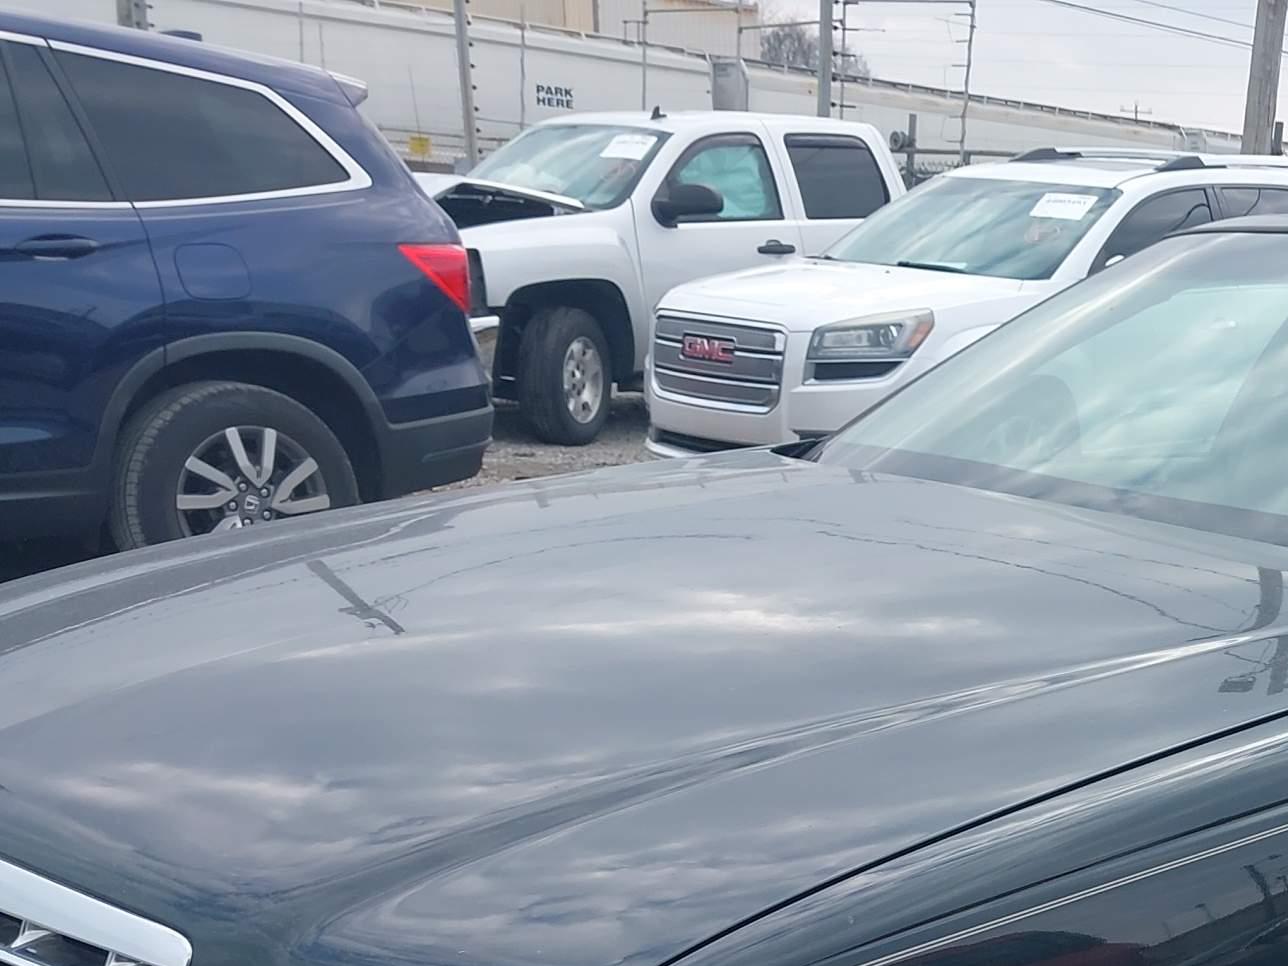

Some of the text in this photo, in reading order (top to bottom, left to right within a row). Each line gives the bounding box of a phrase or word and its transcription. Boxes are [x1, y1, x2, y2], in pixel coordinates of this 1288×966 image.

[536, 84, 573, 98] PARK
[536, 96, 574, 109] HERE
[683, 335, 735, 361] GMC
